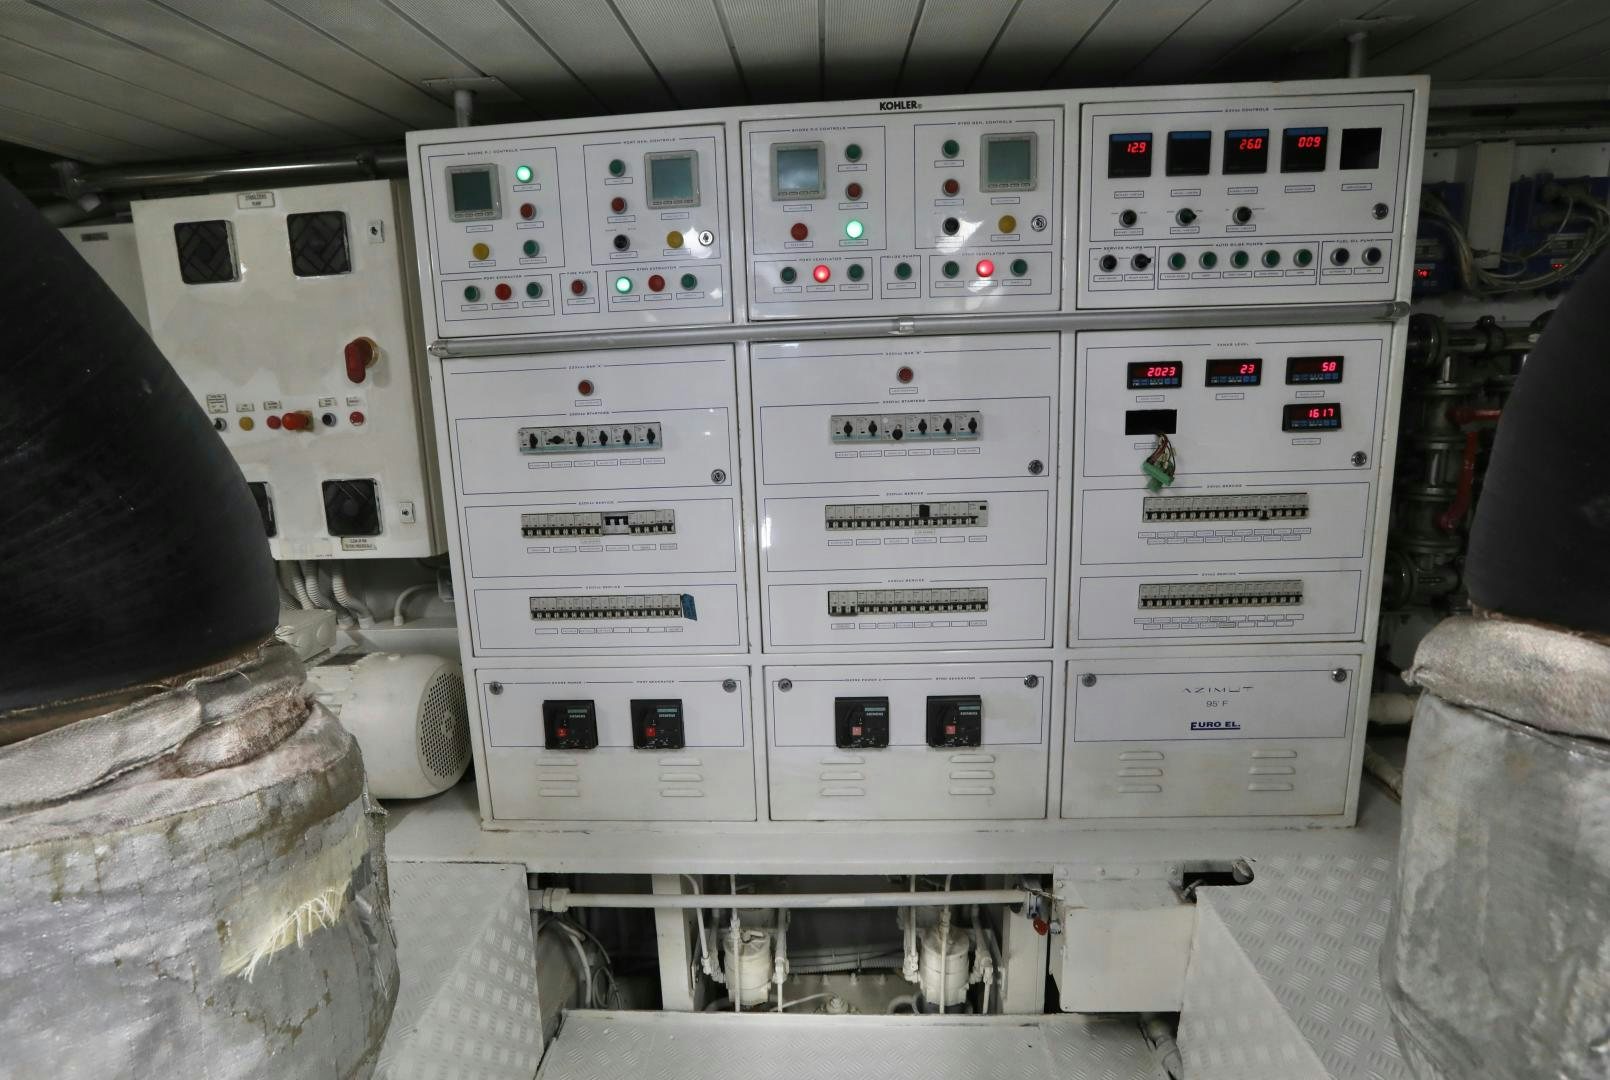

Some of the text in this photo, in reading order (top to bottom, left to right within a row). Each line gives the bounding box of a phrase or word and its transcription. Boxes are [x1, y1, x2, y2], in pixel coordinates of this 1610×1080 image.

[879, 100, 917, 111] KOHLER
[1147, 366, 1176, 377] 2023
[1240, 364, 1255, 374] 23
[1322, 361, 1336, 372] 58
[1191, 721, 1221, 730] EURO
